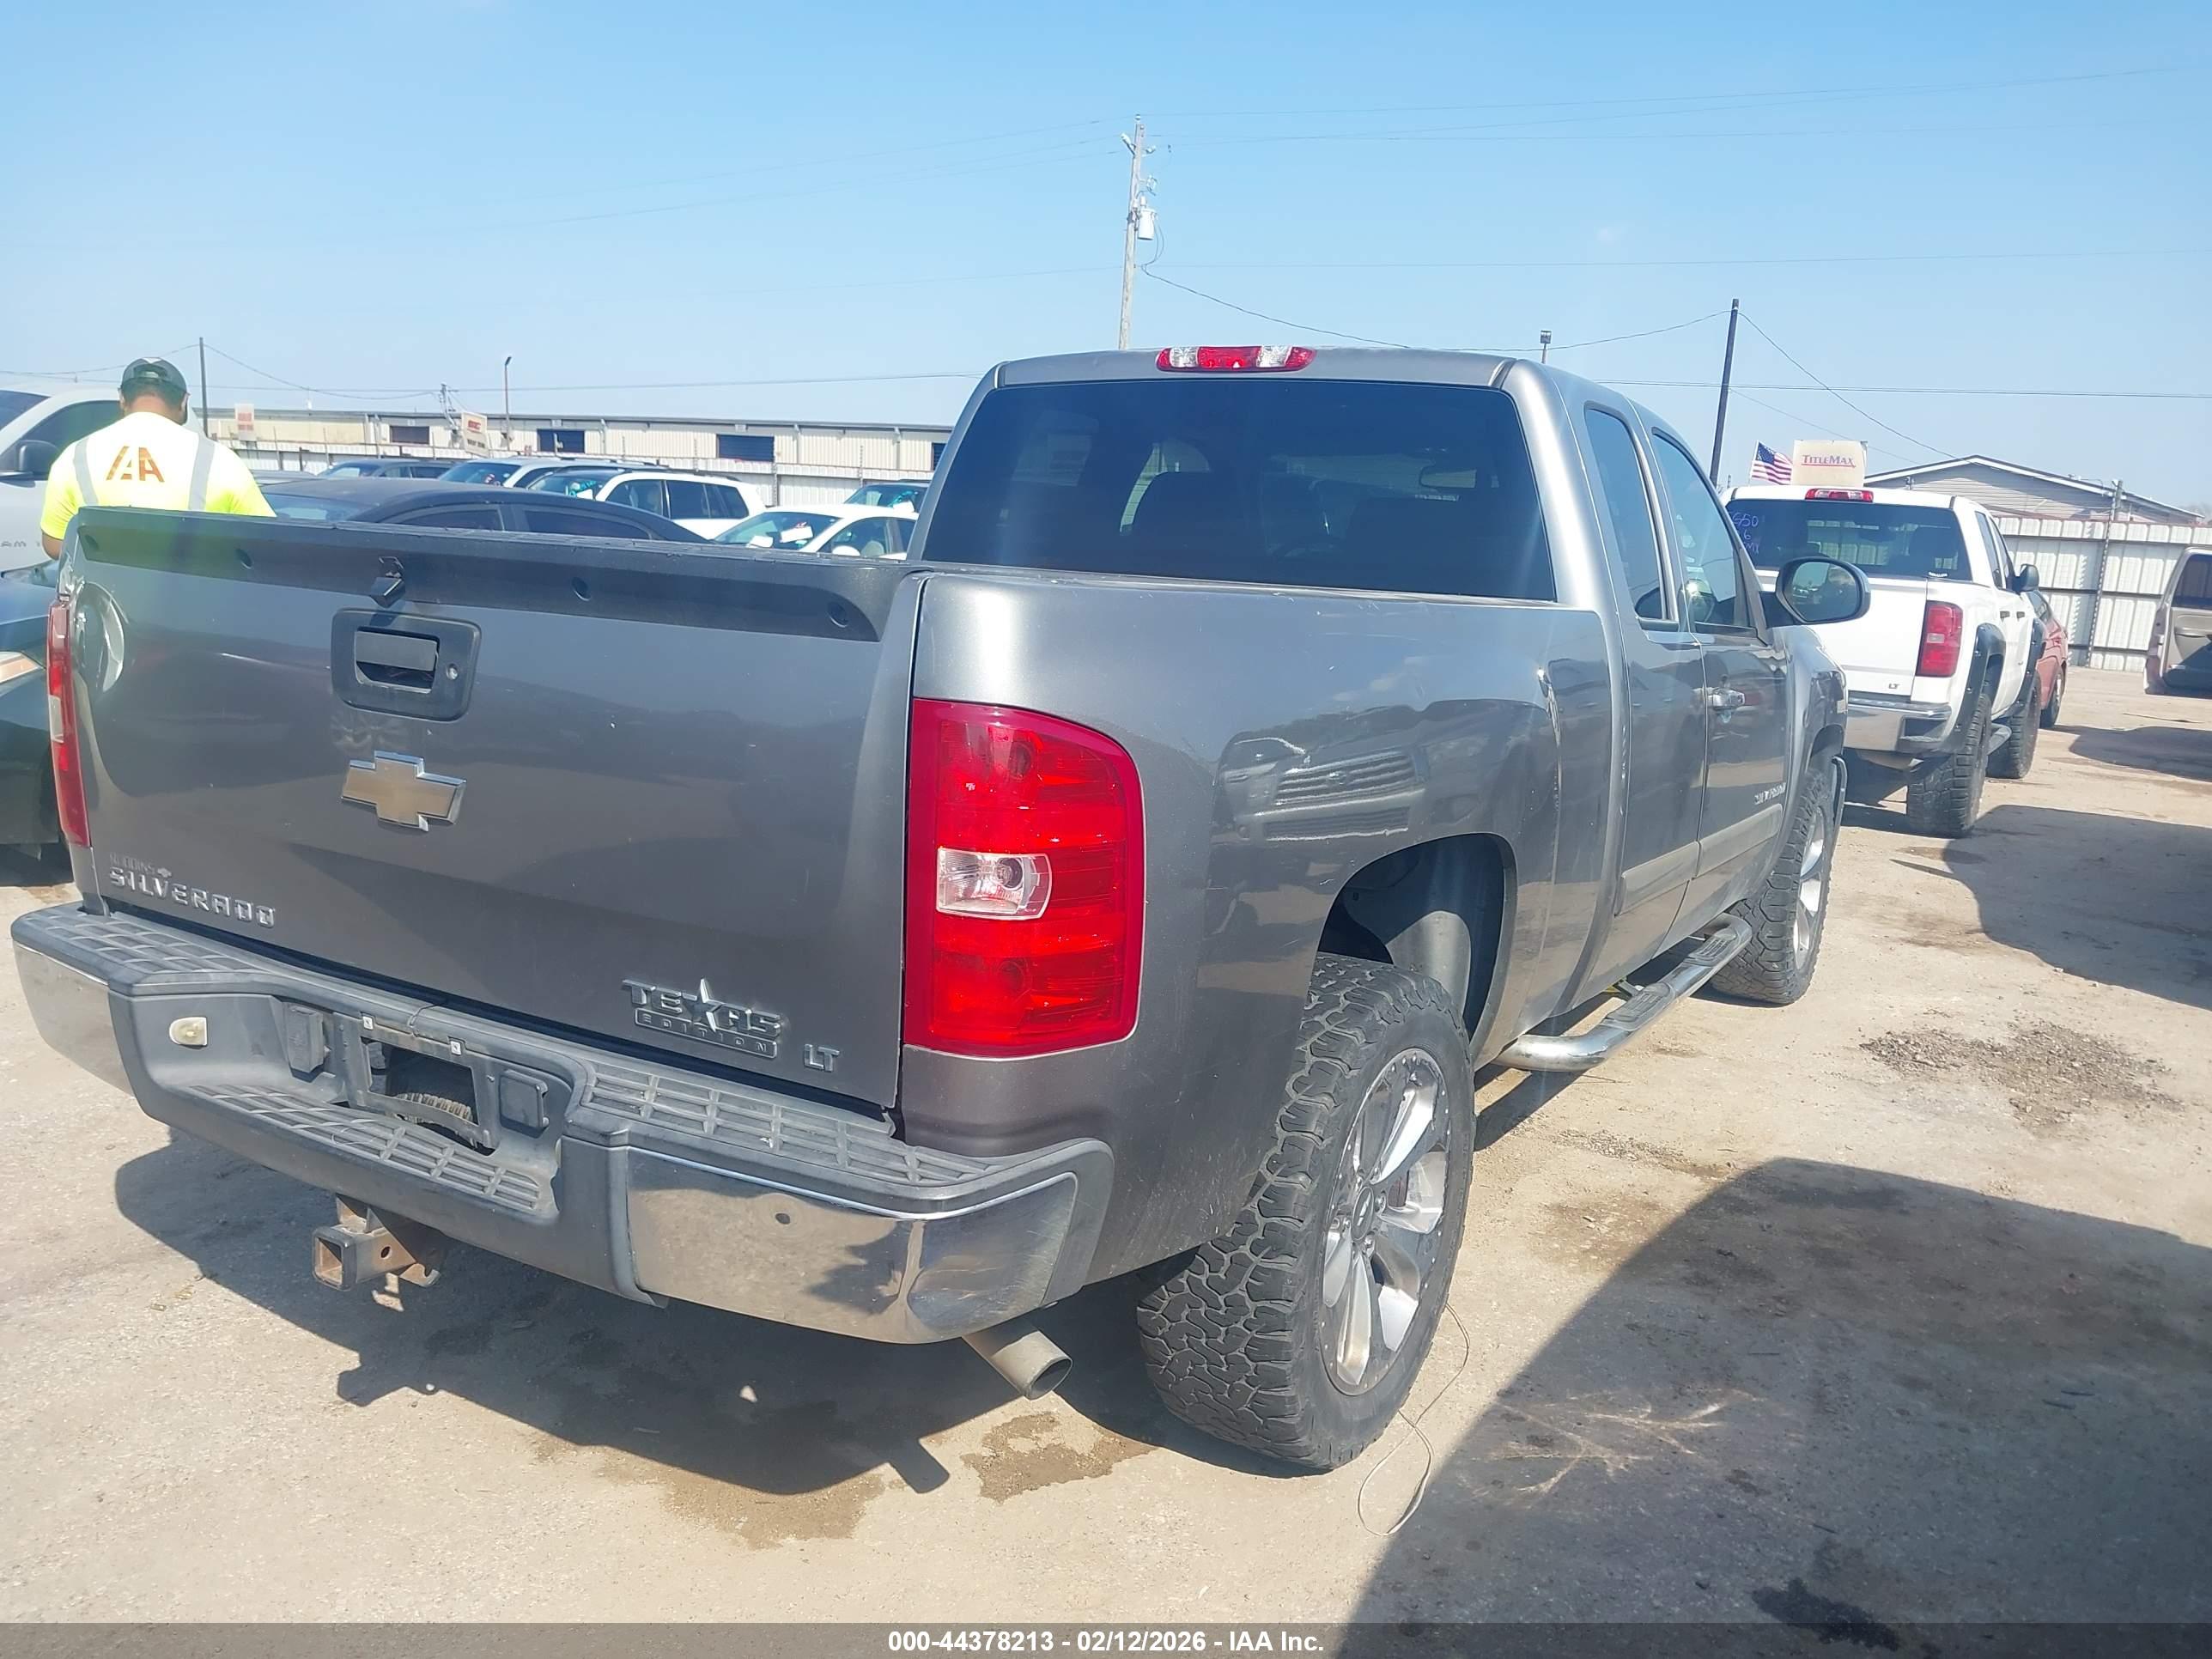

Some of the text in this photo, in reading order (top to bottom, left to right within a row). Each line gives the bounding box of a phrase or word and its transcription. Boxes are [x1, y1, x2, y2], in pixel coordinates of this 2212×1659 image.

[109, 866, 276, 928] SILVERADO
[623, 977, 781, 1037] TEXAS
[641, 1012, 768, 1053] EDITION
[804, 1043, 841, 1073] LT
